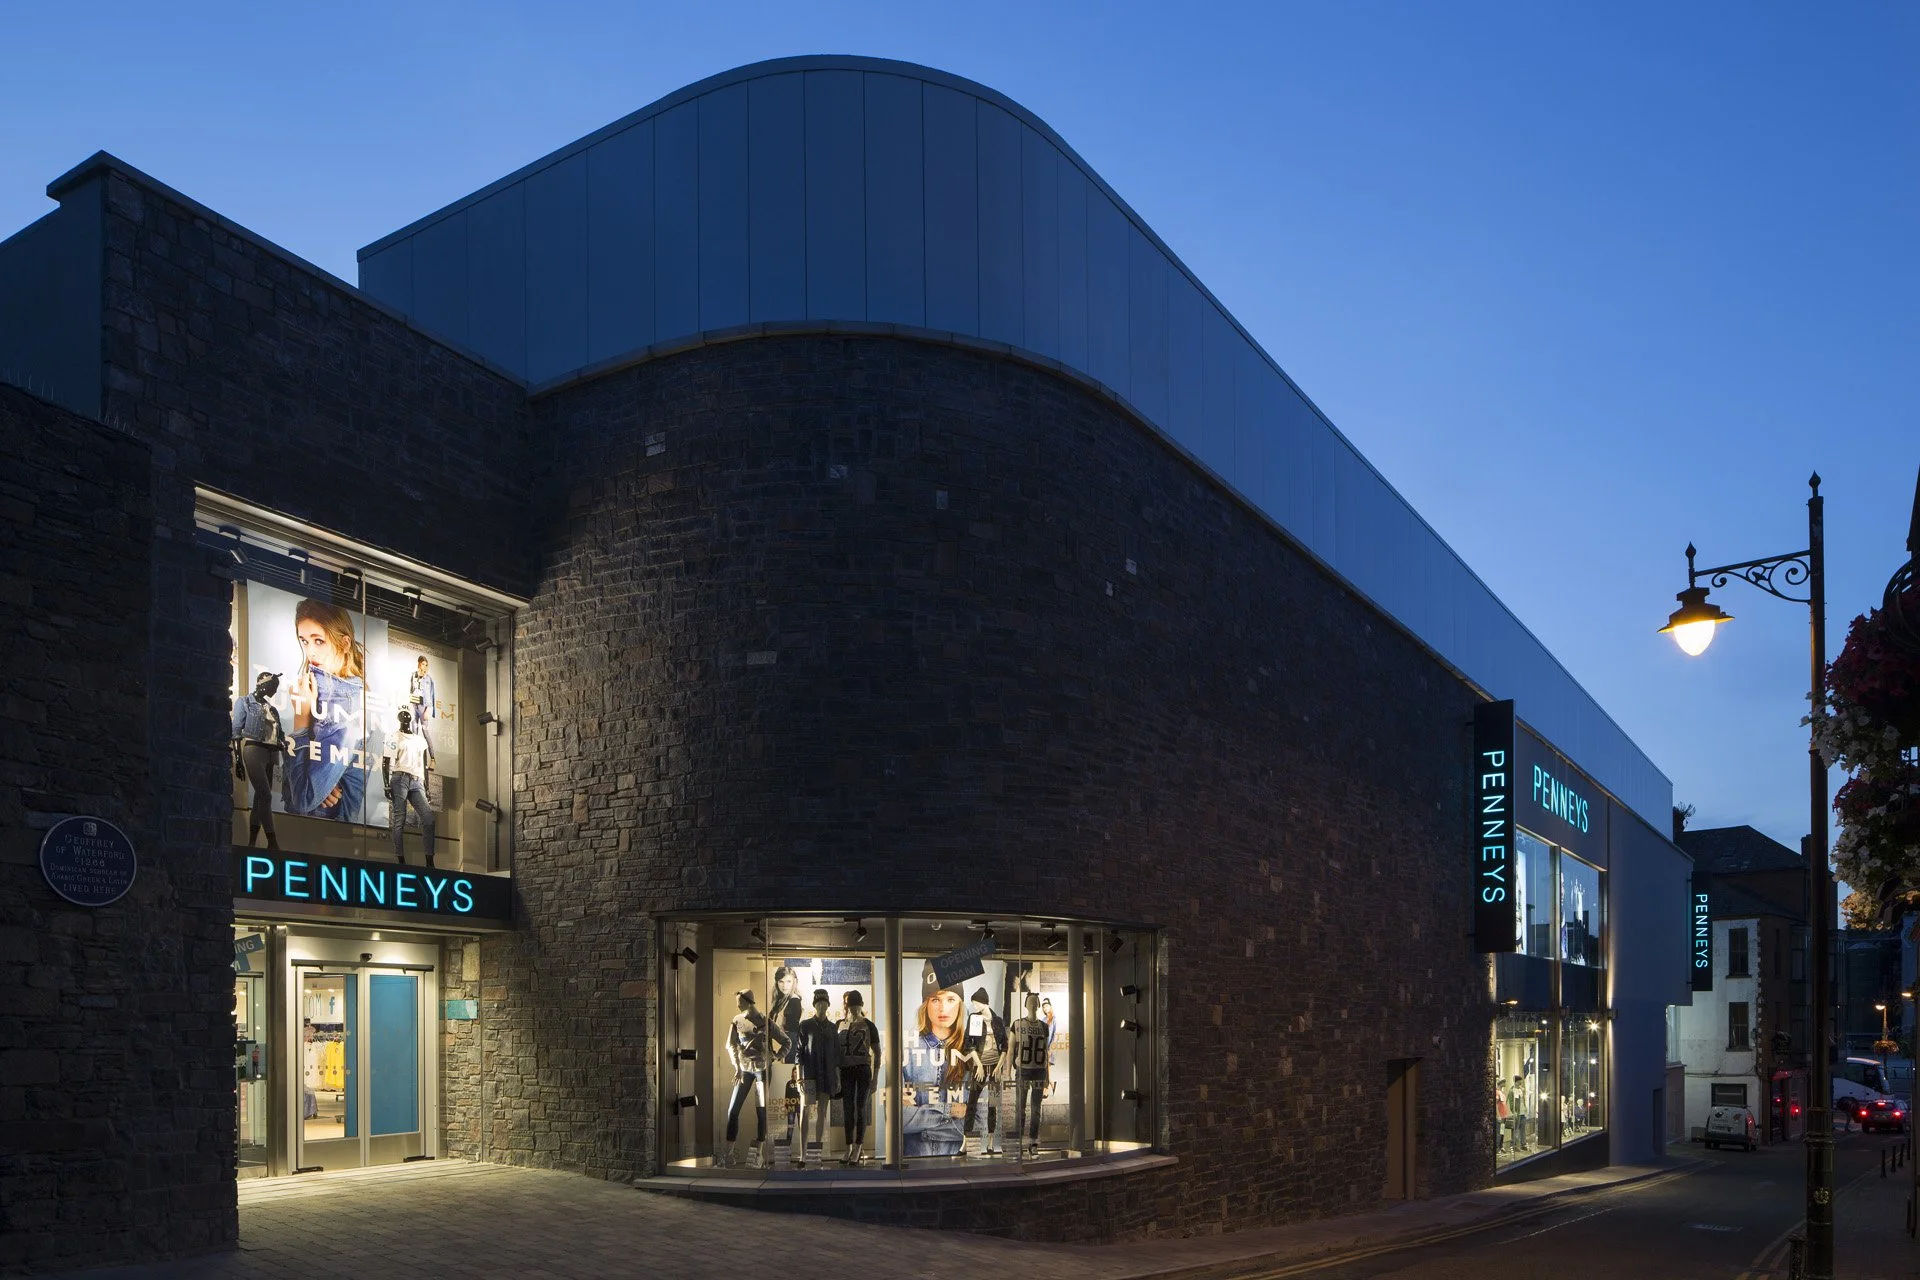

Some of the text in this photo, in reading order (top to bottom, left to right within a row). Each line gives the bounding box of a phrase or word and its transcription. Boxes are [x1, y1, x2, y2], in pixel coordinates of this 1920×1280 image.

[1482, 750, 1505, 903] PENNEYS
[1533, 764, 1589, 834] PENNEYS
[246, 856, 474, 913] PENNEYS
[234, 939, 255, 954] ING
[940, 943, 989, 968] OPENING
[1695, 893, 1708, 969] PENNEYS
[945, 964, 976, 983] 10AM
